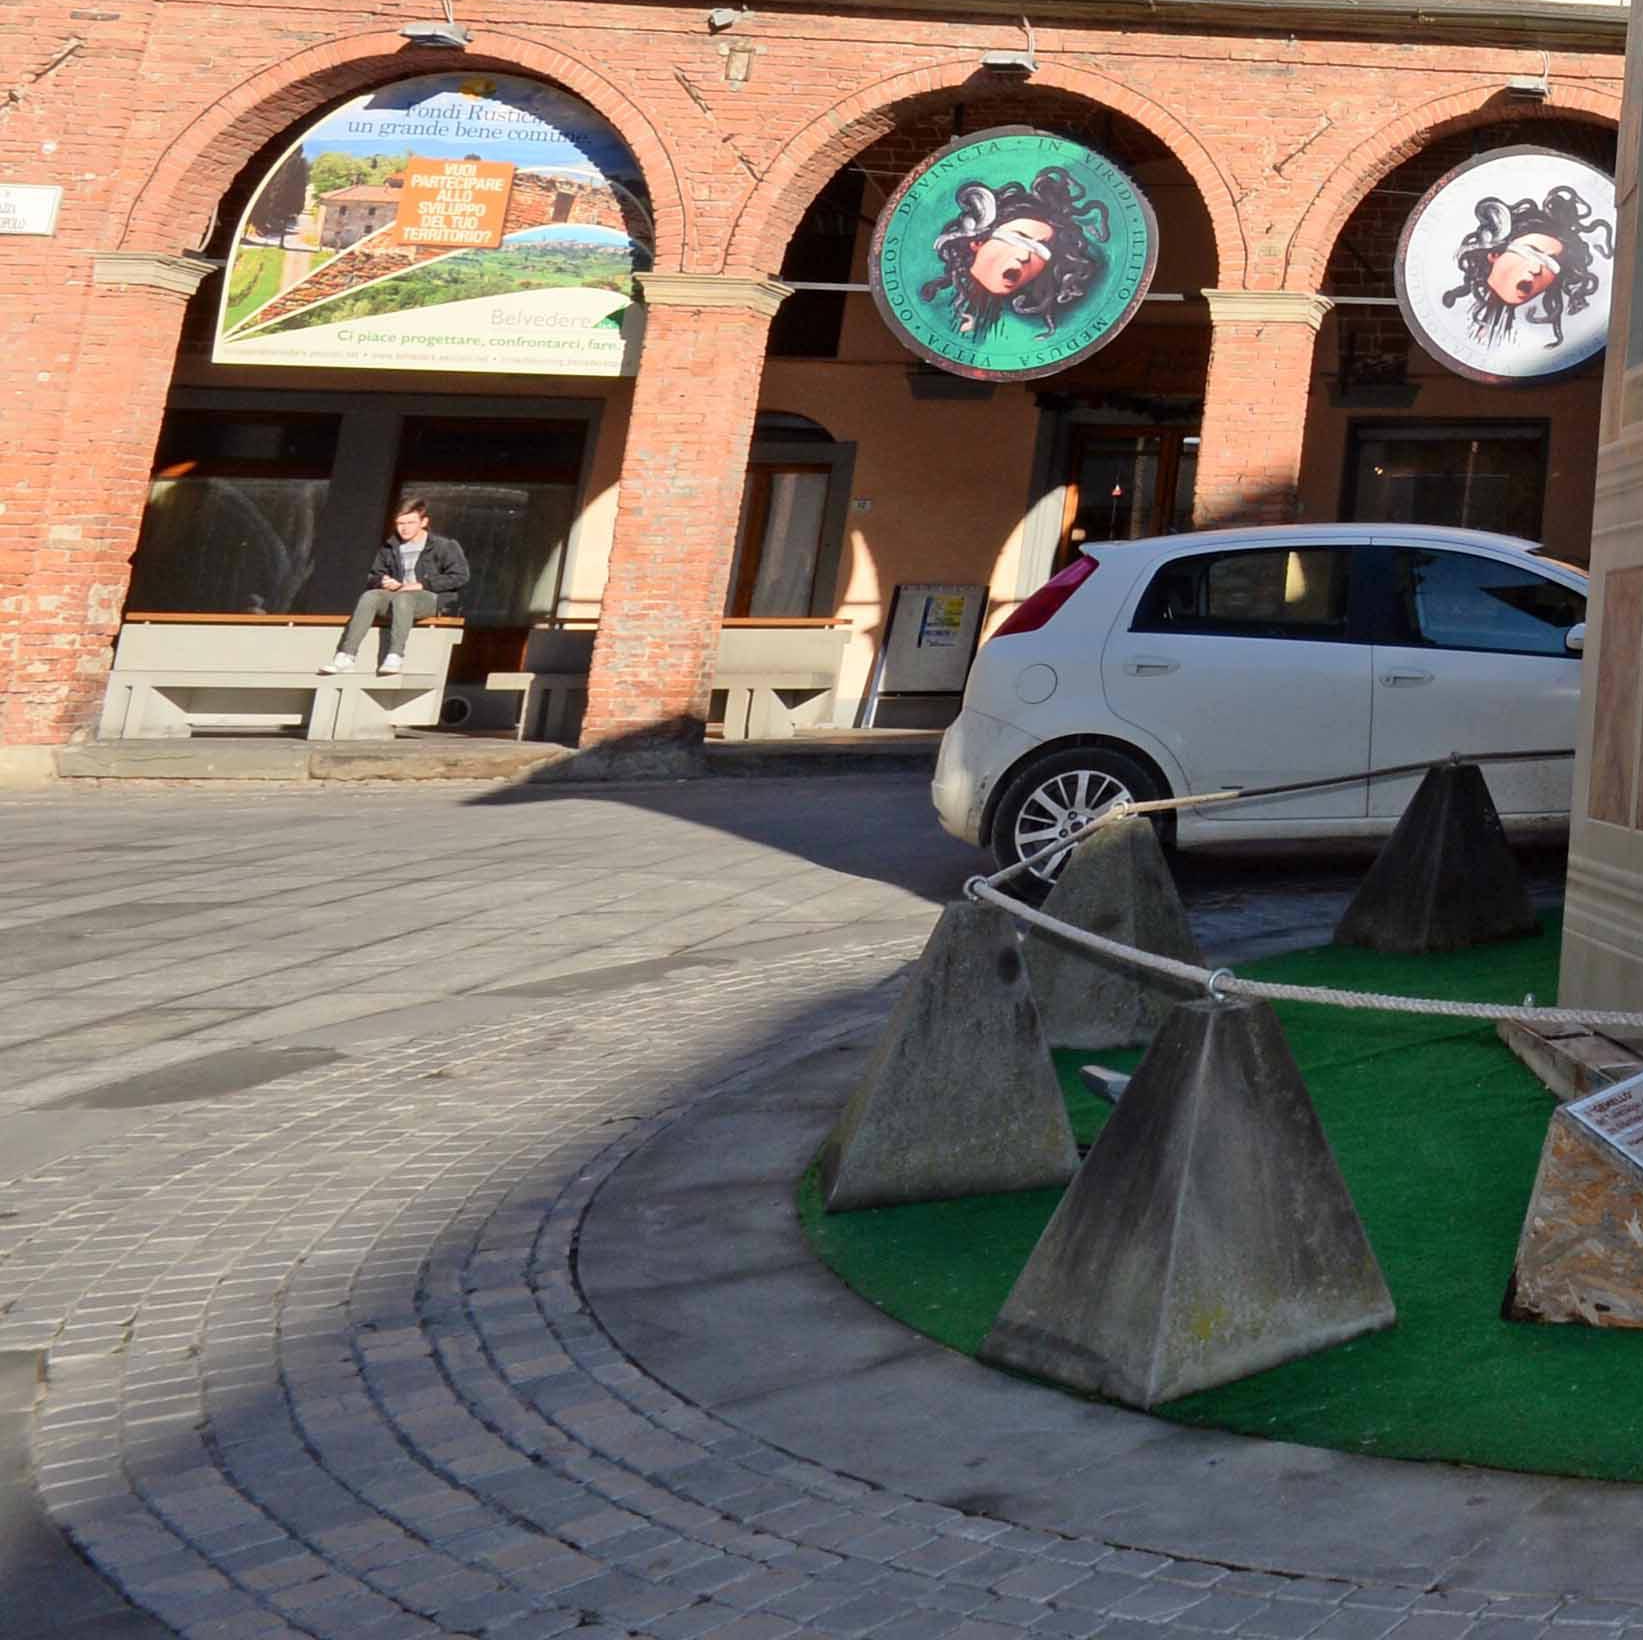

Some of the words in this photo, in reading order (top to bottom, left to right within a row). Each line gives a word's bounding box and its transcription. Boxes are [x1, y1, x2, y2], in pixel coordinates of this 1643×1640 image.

[348, 121, 372, 133] un
[379, 120, 449, 137] grande
[456, 120, 503, 139] bene
[1038, 139, 1063, 152] IN
[444, 163, 477, 177] VUOI
[899, 141, 1000, 217] DEVINCTA
[1083, 148, 1138, 209] VIRIDI
[411, 174, 504, 192] PARTECIPARE
[436, 189, 473, 202] ALLO
[417, 201, 487, 217] SVILUPPO
[421, 215, 445, 228] DEL
[451, 216, 479, 230] TUO
[403, 227, 492, 243] TERRITORIO?
[884, 236, 913, 323] OCULOS
[490, 308, 592, 328] Belvedere
[337, 329, 353, 342] Ci
[357, 331, 397, 347] piace
[400, 333, 485, 348] progettare,
[489, 336, 585, 351] confrontarci,
[1019, 318, 1109, 367] MEDUSA
[927, 333, 992, 368] VITTA
